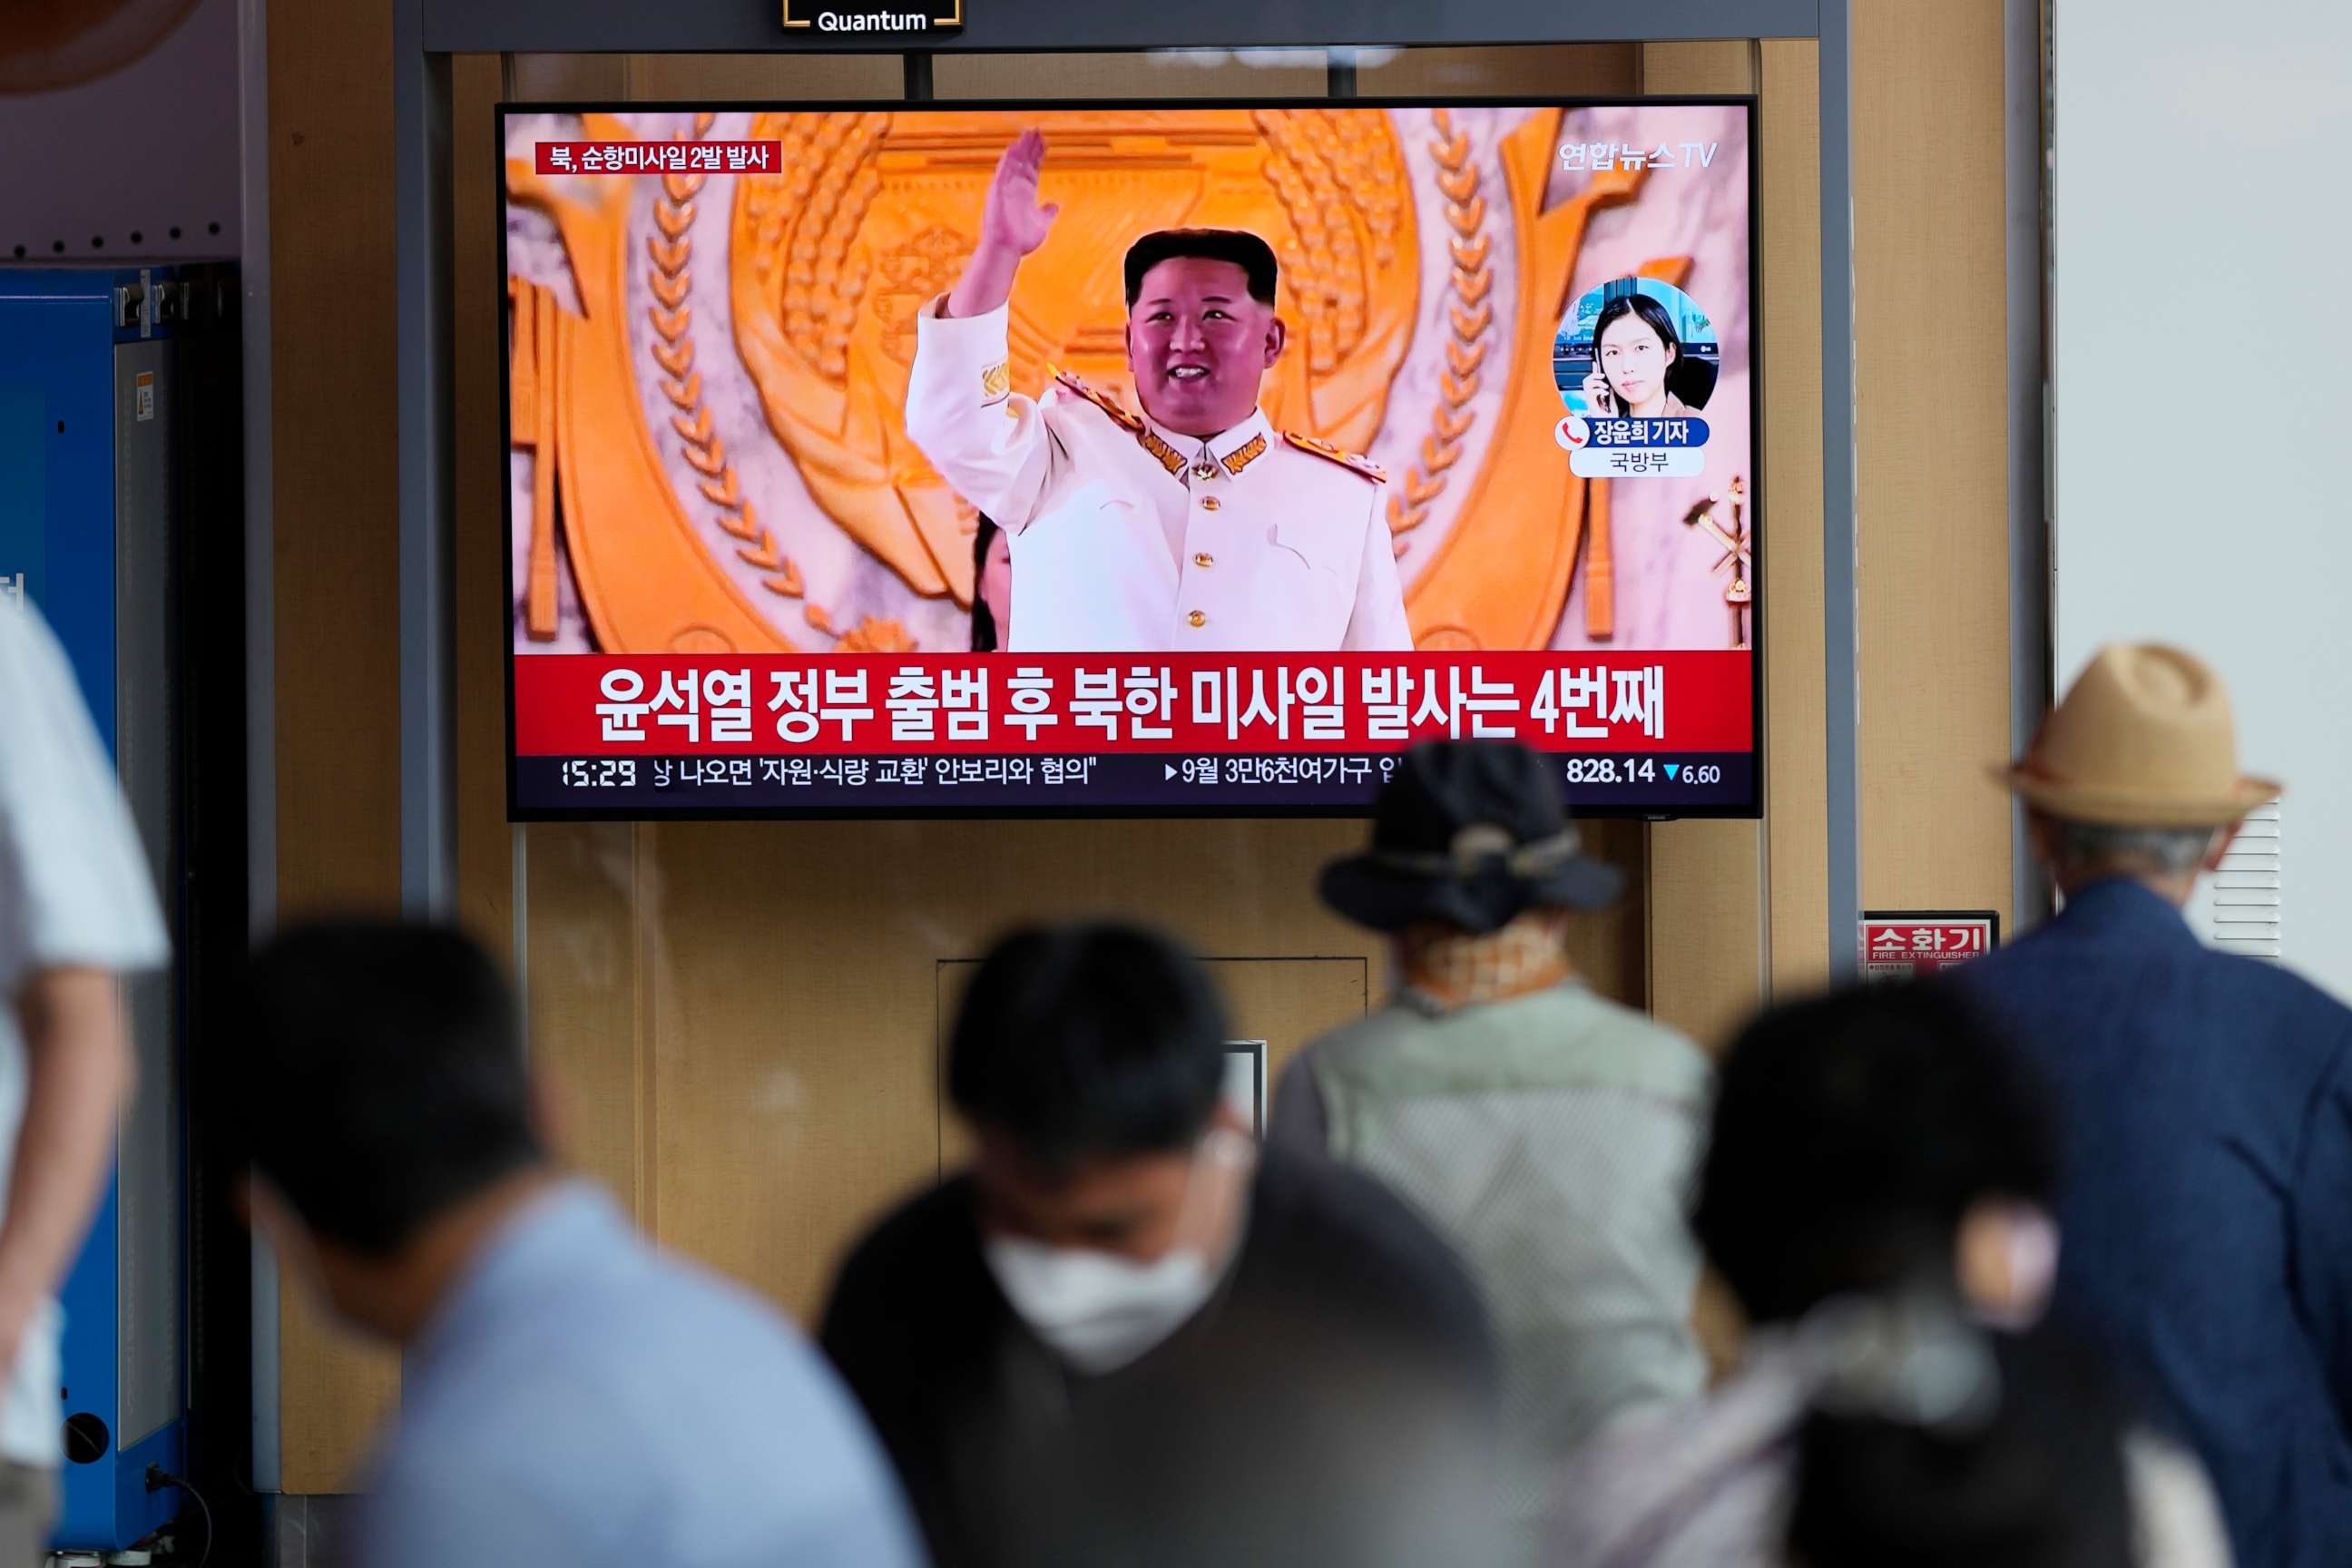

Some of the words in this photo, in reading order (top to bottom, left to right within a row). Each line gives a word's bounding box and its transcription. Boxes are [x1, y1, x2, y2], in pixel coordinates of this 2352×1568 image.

[818, 10, 926, 32] Quantum
[550, 146, 578, 172] 북,
[581, 145, 687, 171] 순항미사일
[690, 145, 723, 170] 2발
[726, 144, 769, 170] 발사
[1593, 420, 1649, 446] 장윤희
[1651, 420, 1690, 445] 기자
[1609, 450, 1670, 473] 국방부
[595, 668, 753, 743] 윤석열
[767, 668, 874, 743] 정부
[885, 666, 989, 741] 출범
[1004, 667, 1058, 741] 후
[1069, 666, 1179, 741] 북한
[1191, 666, 1346, 740] 미사일
[1361, 665, 1521, 740] 발사는
[1530, 665, 1664, 740] 4번째
[562, 760, 636, 787] 15:29
[680, 759, 752, 787] 나오면
[875, 757, 928, 785] 교환'
[935, 758, 1034, 785] 안보리와
[1040, 756, 1097, 785] 협의"
[1181, 757, 1219, 784] 9월
[1225, 757, 1373, 784] 3만6천여가구
[1566, 758, 1656, 783] 828.14
[1682, 765, 1720, 785] 6.60
[1872, 927, 1980, 951] 소화기
[1872, 951, 1896, 959] FIRE
[1901, 951, 1979, 959] EXTINGUISHER
